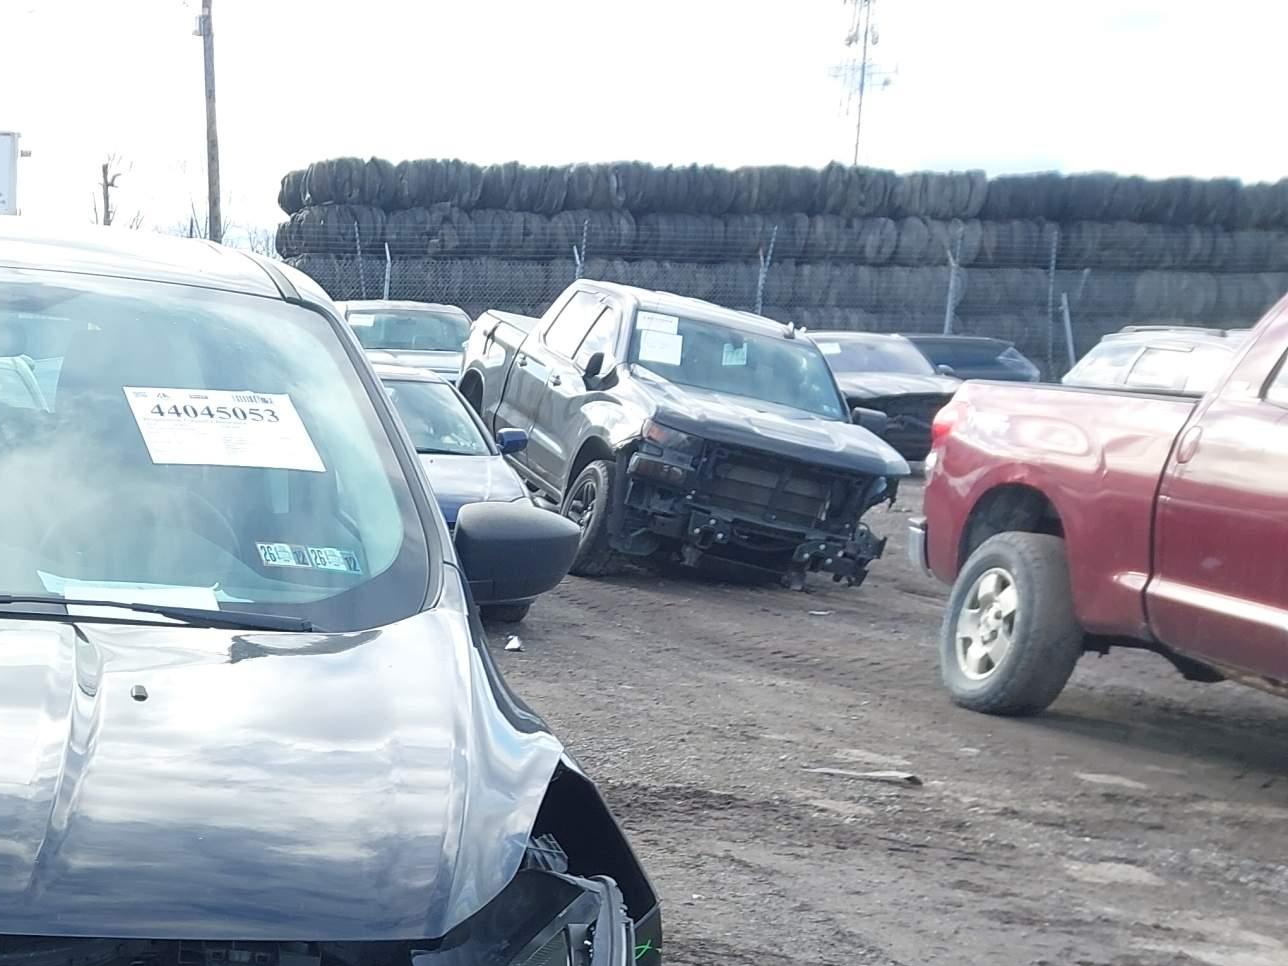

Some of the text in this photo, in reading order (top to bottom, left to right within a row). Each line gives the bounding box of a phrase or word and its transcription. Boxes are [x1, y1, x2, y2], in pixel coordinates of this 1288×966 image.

[150, 403, 280, 423] 44045053
[260, 545, 277, 562] 26
[311, 549, 328, 566] 26
